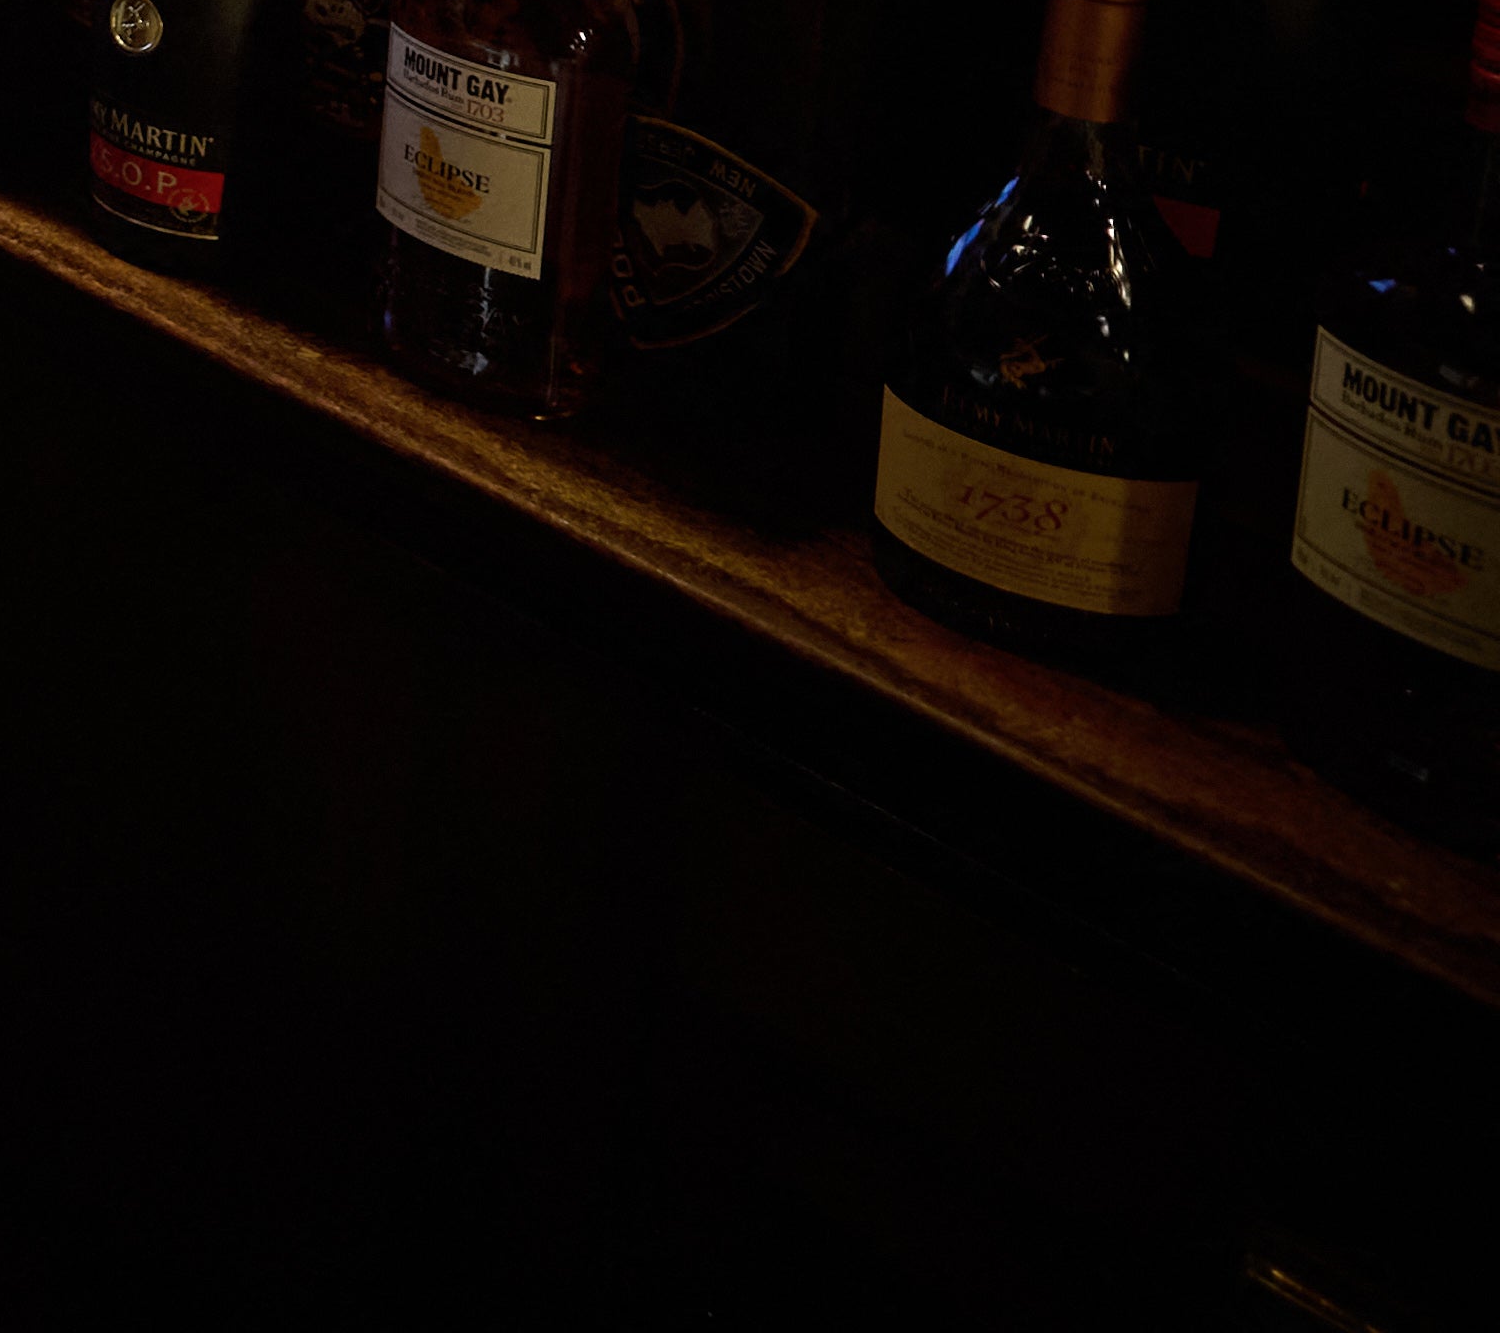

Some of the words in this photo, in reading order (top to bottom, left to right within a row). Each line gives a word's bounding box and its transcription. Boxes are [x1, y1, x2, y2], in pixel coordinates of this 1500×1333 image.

[403, 44, 465, 95] MOUNT
[466, 68, 510, 107] GAY
[110, 108, 210, 157] MARTIN
[466, 97, 506, 123] 1703
[402, 144, 491, 194] ECLIPSE
[706, 159, 759, 200] NEW
[1344, 361, 1436, 427] MOUNT
[957, 482, 1070, 535] 1738
[1341, 486, 1487, 570] ECLIPSE
